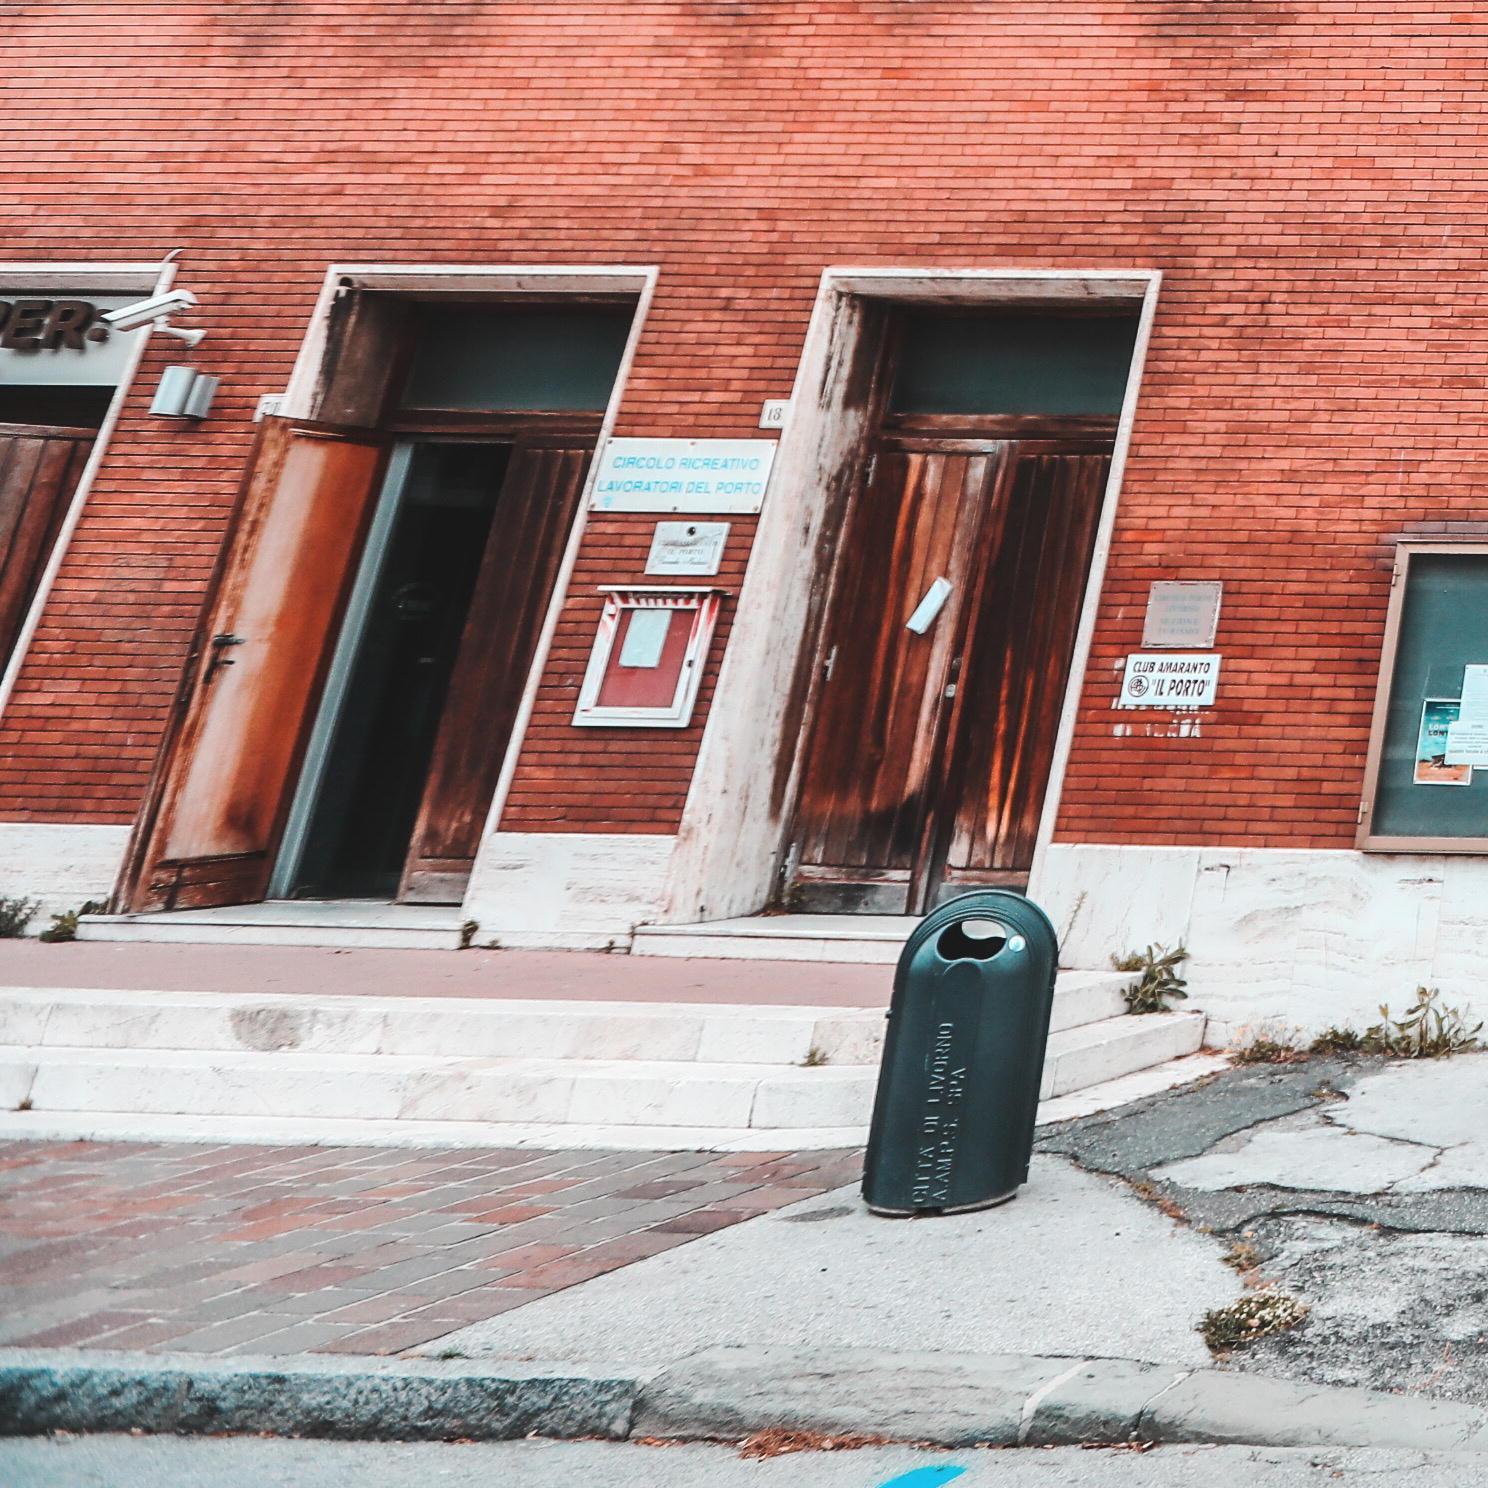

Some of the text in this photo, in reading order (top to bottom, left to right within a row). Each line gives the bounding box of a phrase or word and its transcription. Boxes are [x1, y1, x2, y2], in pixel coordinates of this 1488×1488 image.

[767, 407, 783, 421] 18
[612, 456, 760, 470] CIRCOLO RICREATIVO
[597, 480, 762, 494] LAVORATORI DEL PORTO
[1132, 661, 1211, 674] CLUB AMARANTO
[1152, 678, 1211, 697] "IL PORTO"
[927, 1023, 953, 1103] LIVORNO
